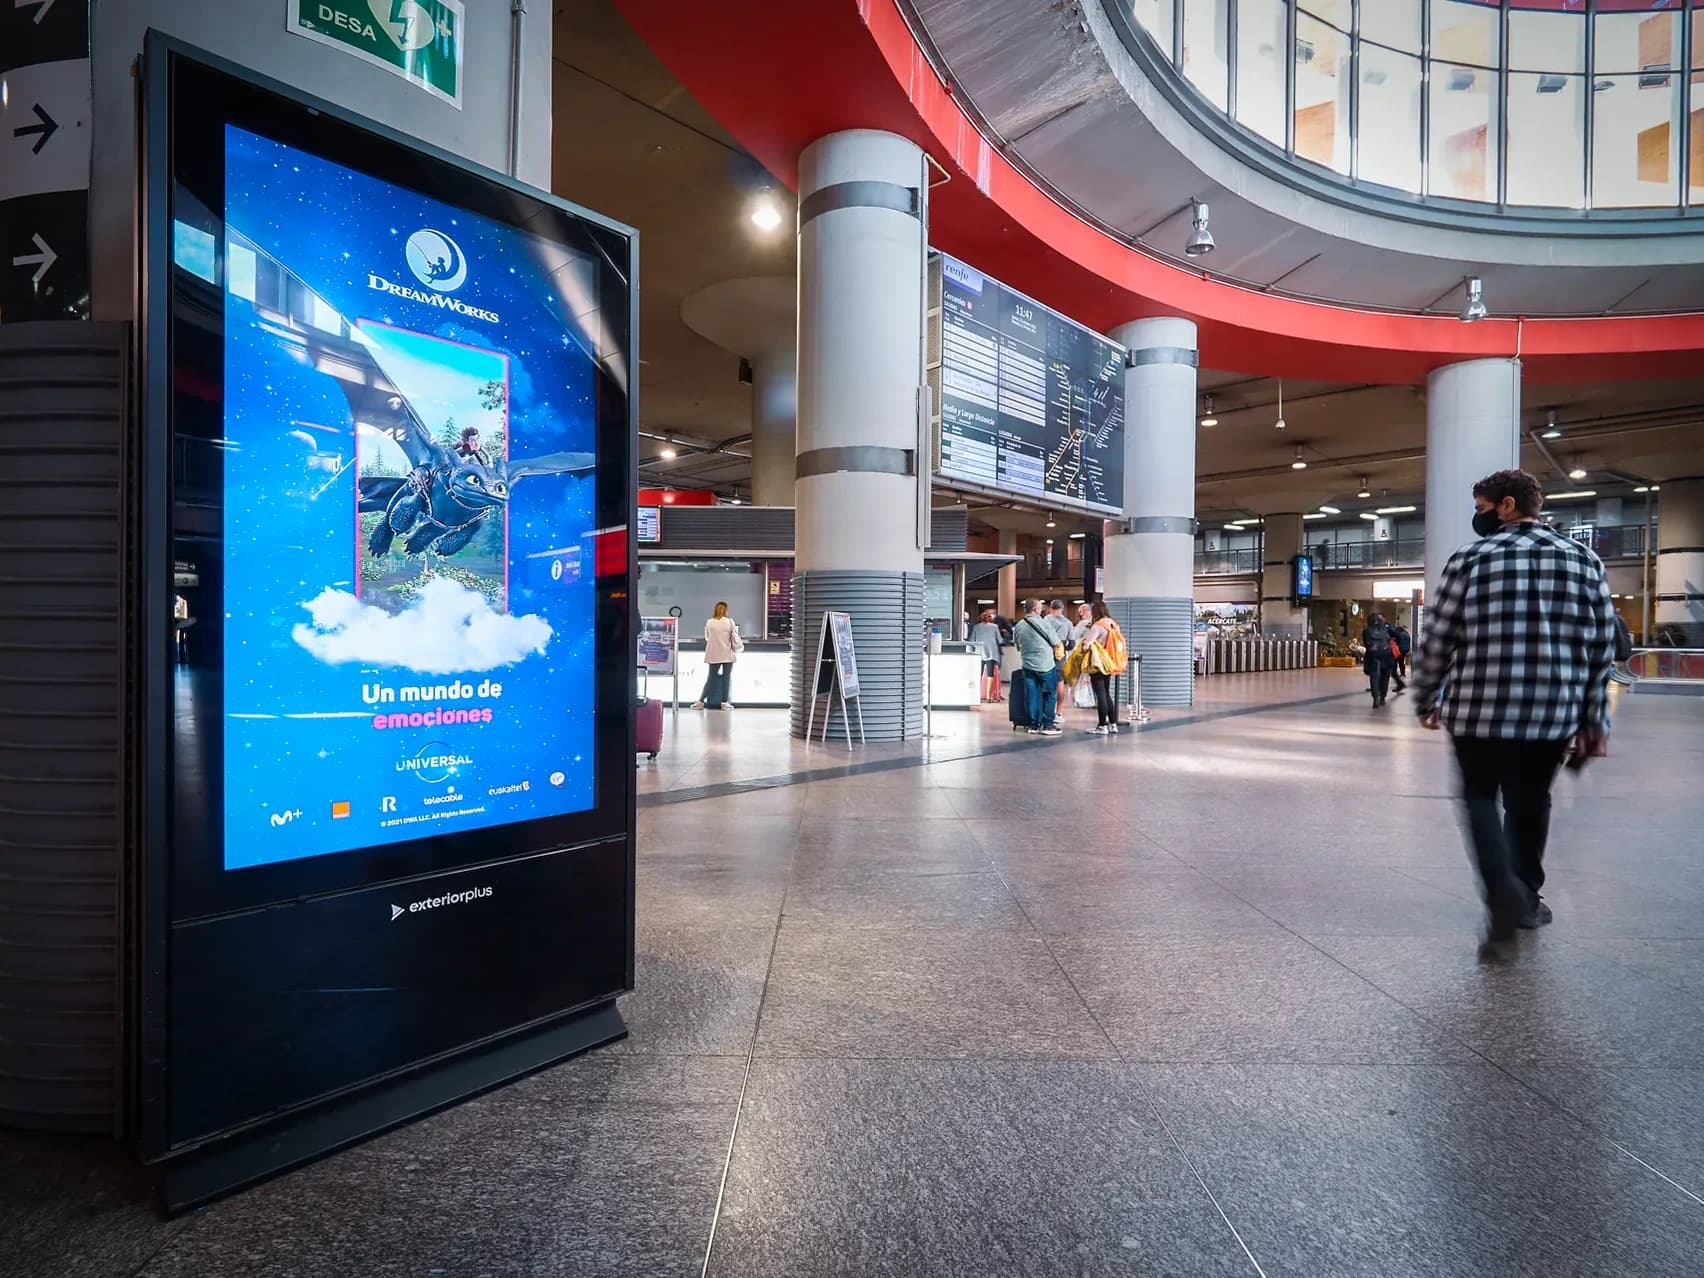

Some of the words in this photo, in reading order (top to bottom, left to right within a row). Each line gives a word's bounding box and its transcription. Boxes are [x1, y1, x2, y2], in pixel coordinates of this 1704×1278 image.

[318, 4, 377, 42] DESA
[945, 264, 969, 281] renfe
[1015, 304, 1033, 321] 11:47
[362, 684, 396, 704] Un
[400, 680, 474, 702] mundo
[477, 679, 503, 698] de
[373, 706, 493, 730] emociones
[395, 754, 474, 771] UNIVERSAL
[440, 809, 459, 820] Rights
[409, 886, 493, 912] exteriorplus
